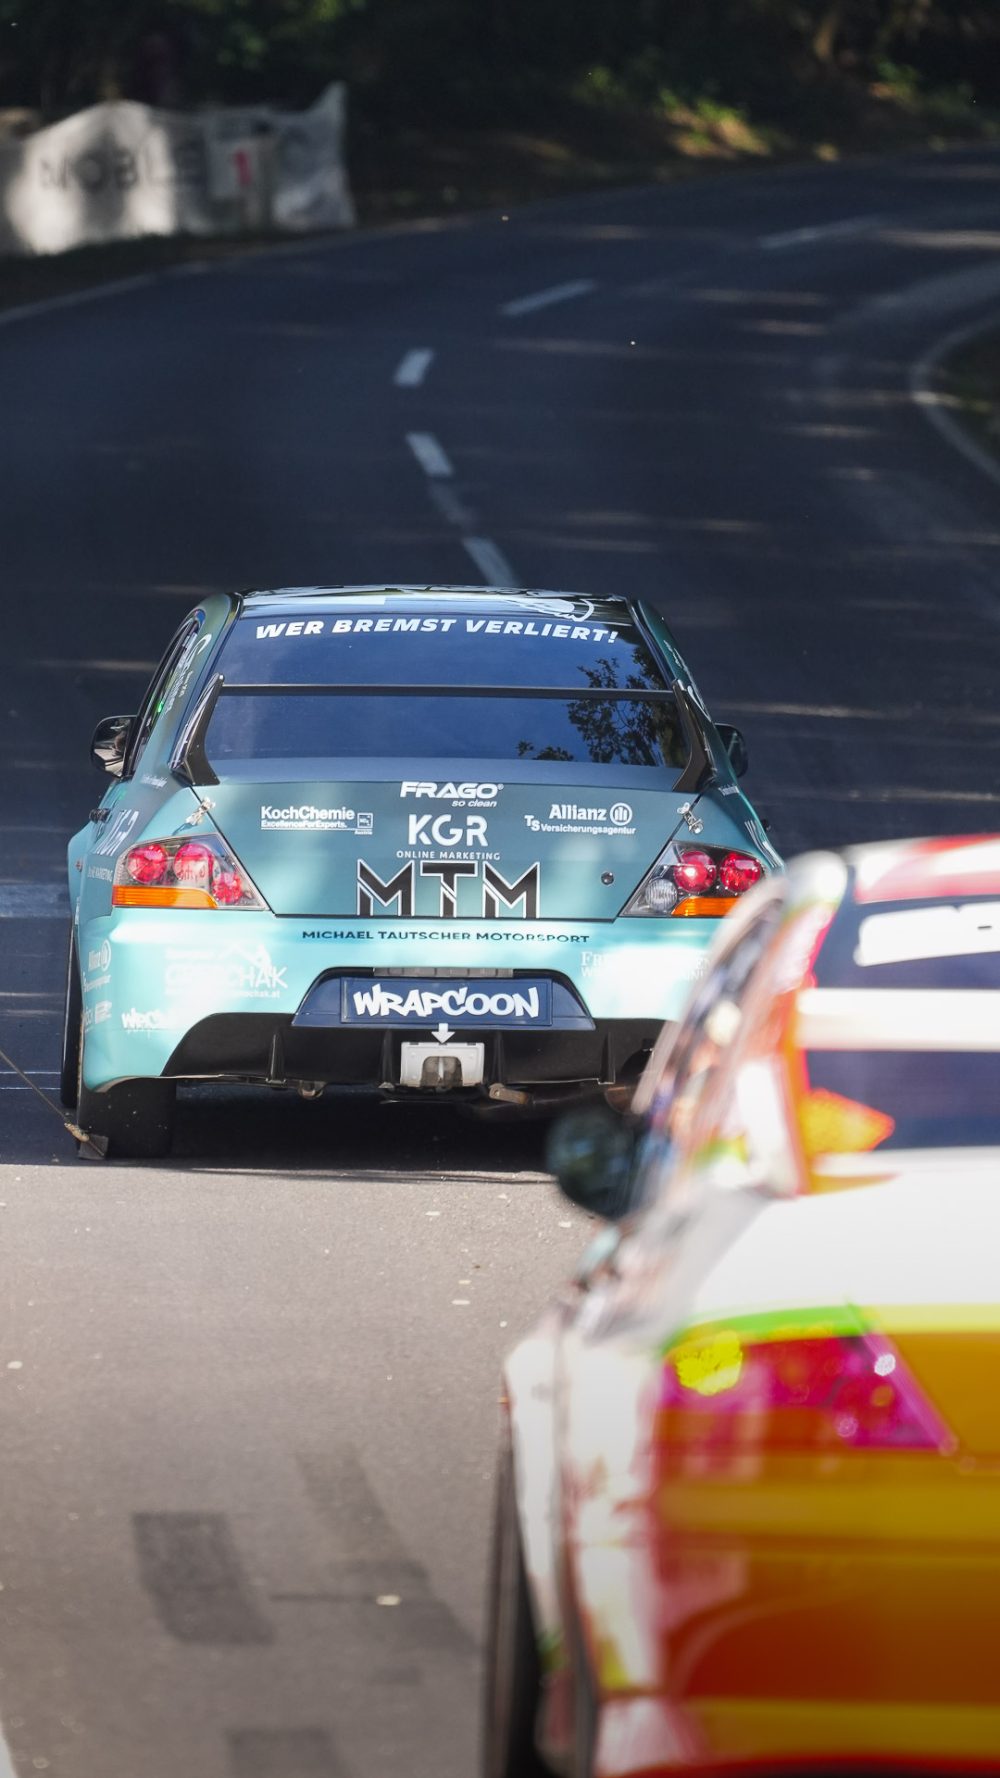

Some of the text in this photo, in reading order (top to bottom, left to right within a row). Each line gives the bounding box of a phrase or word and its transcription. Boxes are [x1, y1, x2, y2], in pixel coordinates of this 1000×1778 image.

[255, 618, 619, 644] WER BREMST VERLIERT!
[451, 798, 498, 808] so clean
[260, 805, 355, 820] KochChemie
[548, 804, 607, 821] Allianz
[407, 813, 489, 847] KGR
[540, 823, 637, 836] Versicherungsagentur
[396, 850, 501, 861] ONLINE MARKETING
[356, 858, 541, 919] MTM
[301, 930, 590, 943] MICHAEL TAUTSCHER MOTORSPORT
[352, 983, 540, 1019] WRAPCOON
